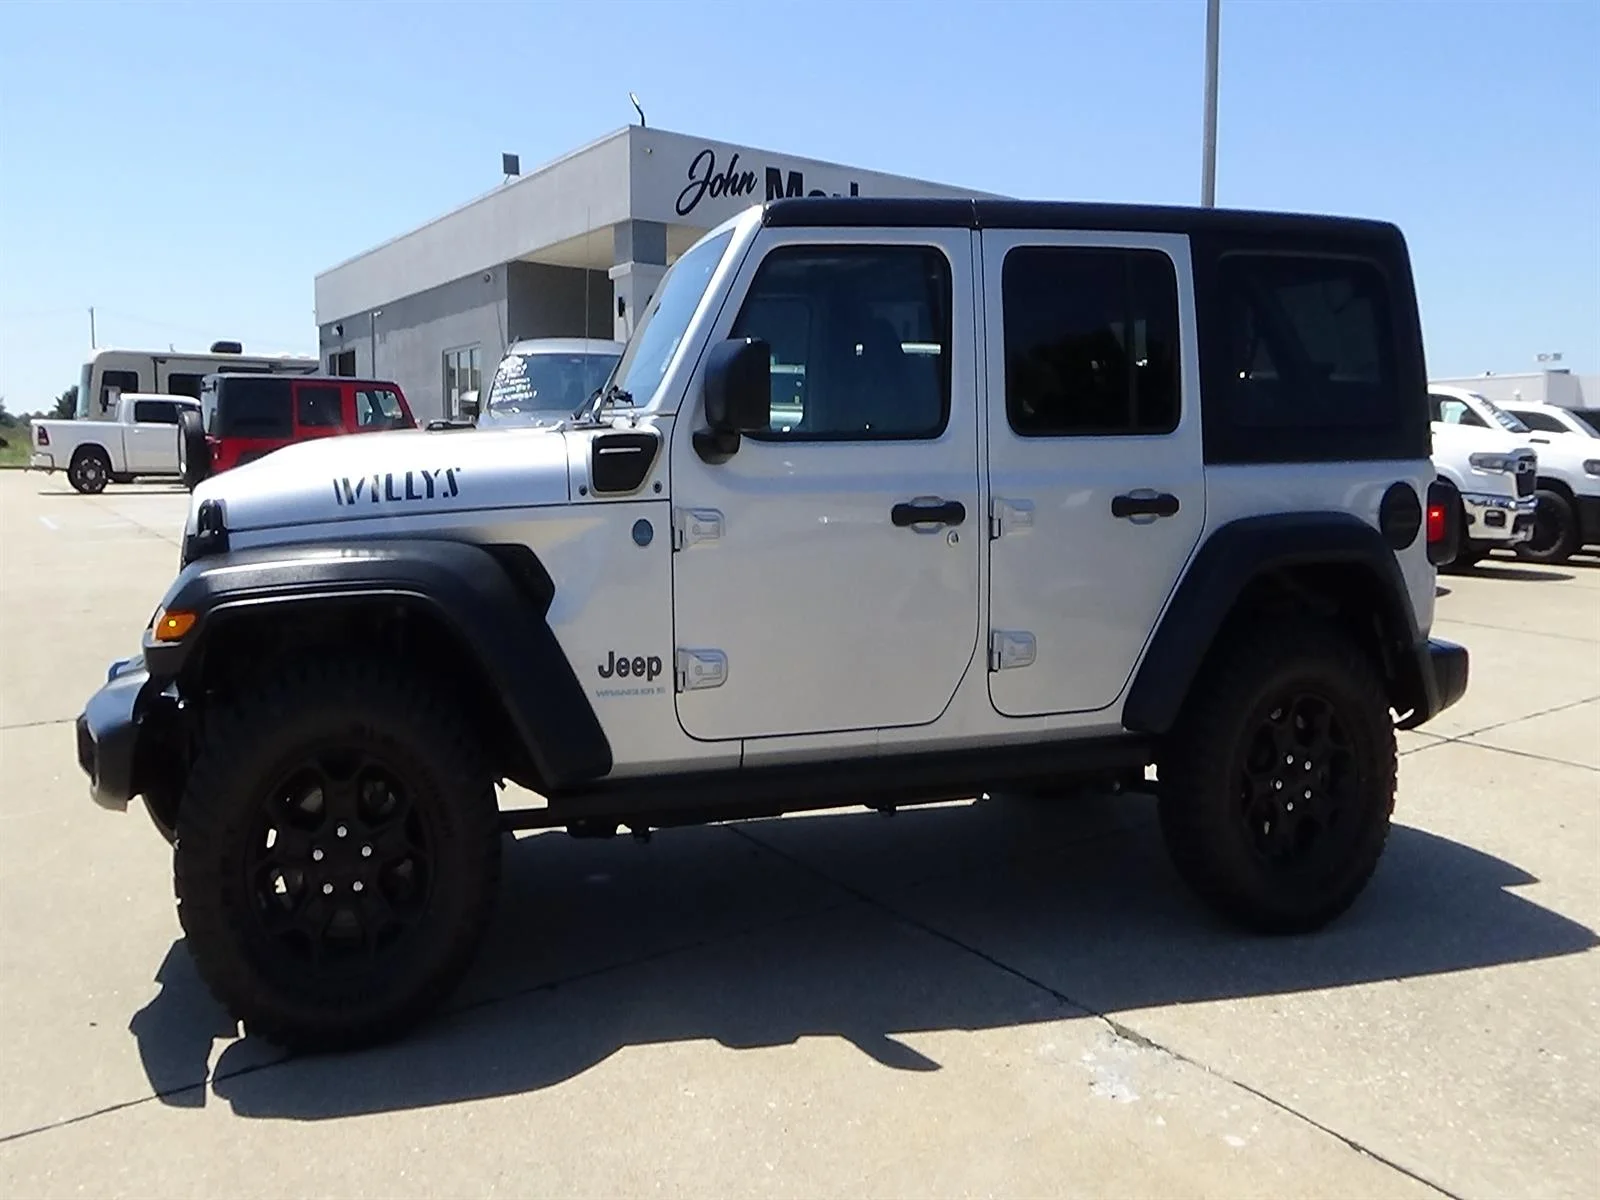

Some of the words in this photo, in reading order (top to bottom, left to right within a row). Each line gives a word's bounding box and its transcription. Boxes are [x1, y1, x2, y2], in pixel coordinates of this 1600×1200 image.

[676, 149, 758, 216] John
[333, 467, 461, 505] WILLYS
[598, 651, 662, 681] Jeep
